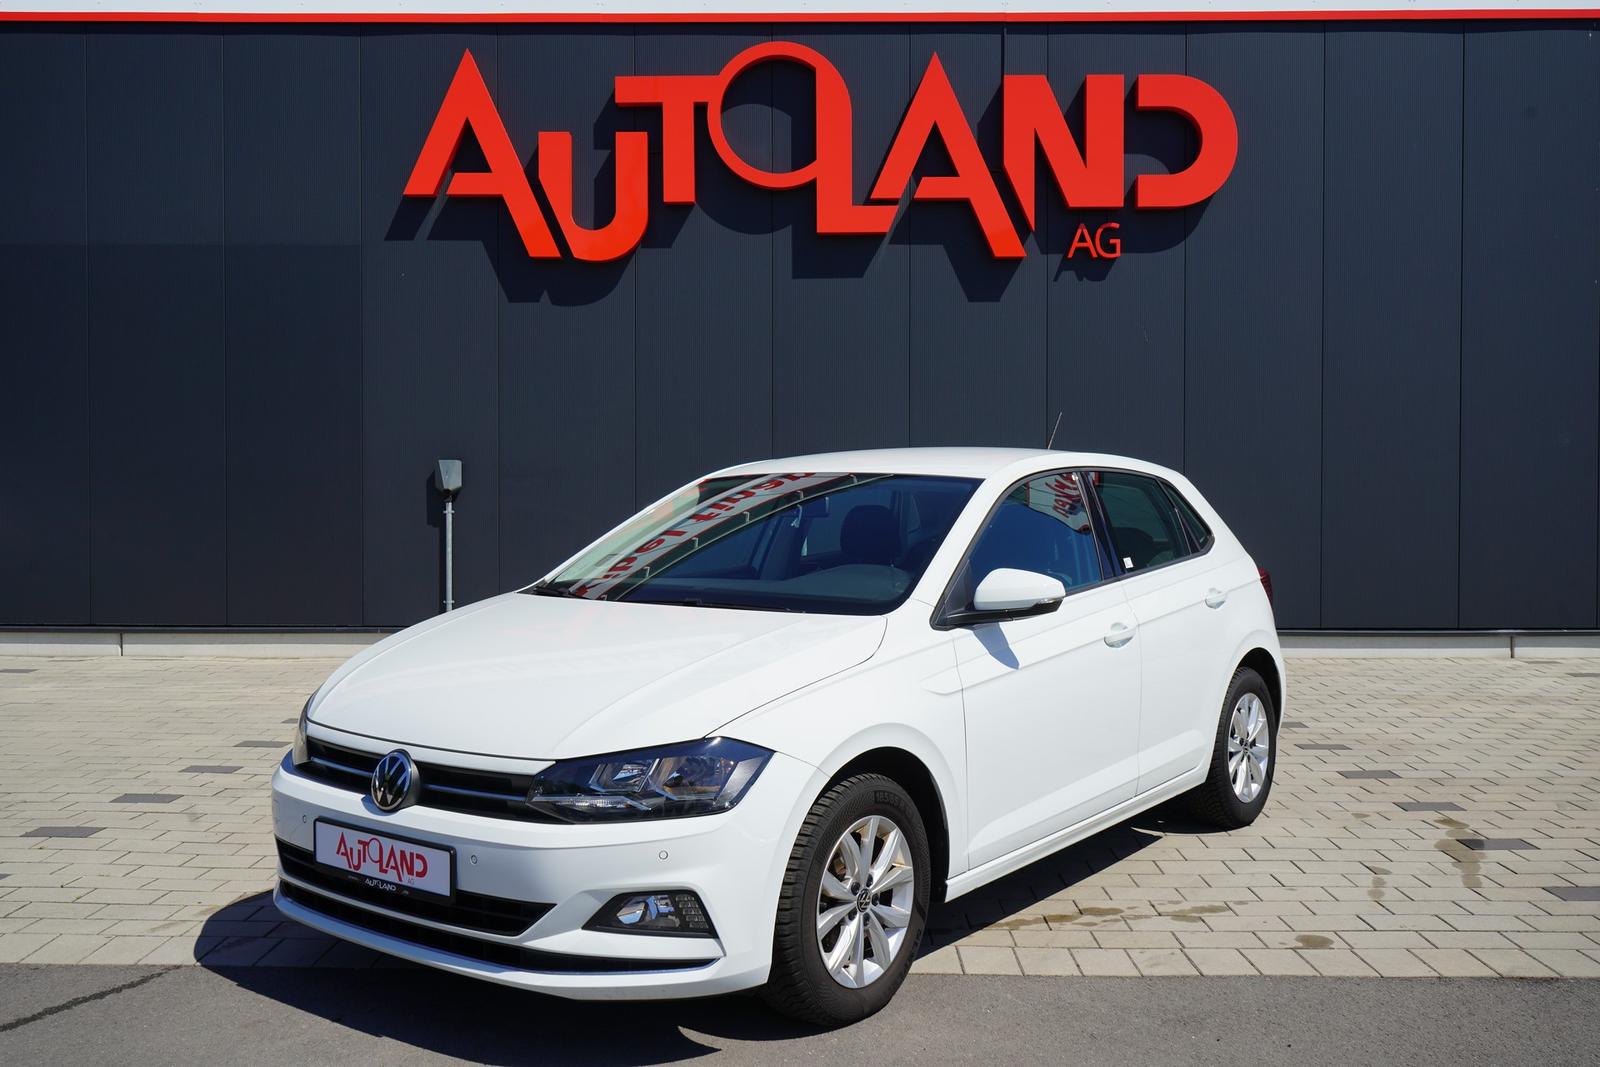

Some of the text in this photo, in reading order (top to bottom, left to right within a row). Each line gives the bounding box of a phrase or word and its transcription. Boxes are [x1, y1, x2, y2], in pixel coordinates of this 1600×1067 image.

[404, 41, 1239, 262] AUTOLAND
[1068, 222, 1122, 258] AG
[336, 831, 429, 882] AUTOLAND
[364, 878, 397, 891] AUTOLAND
